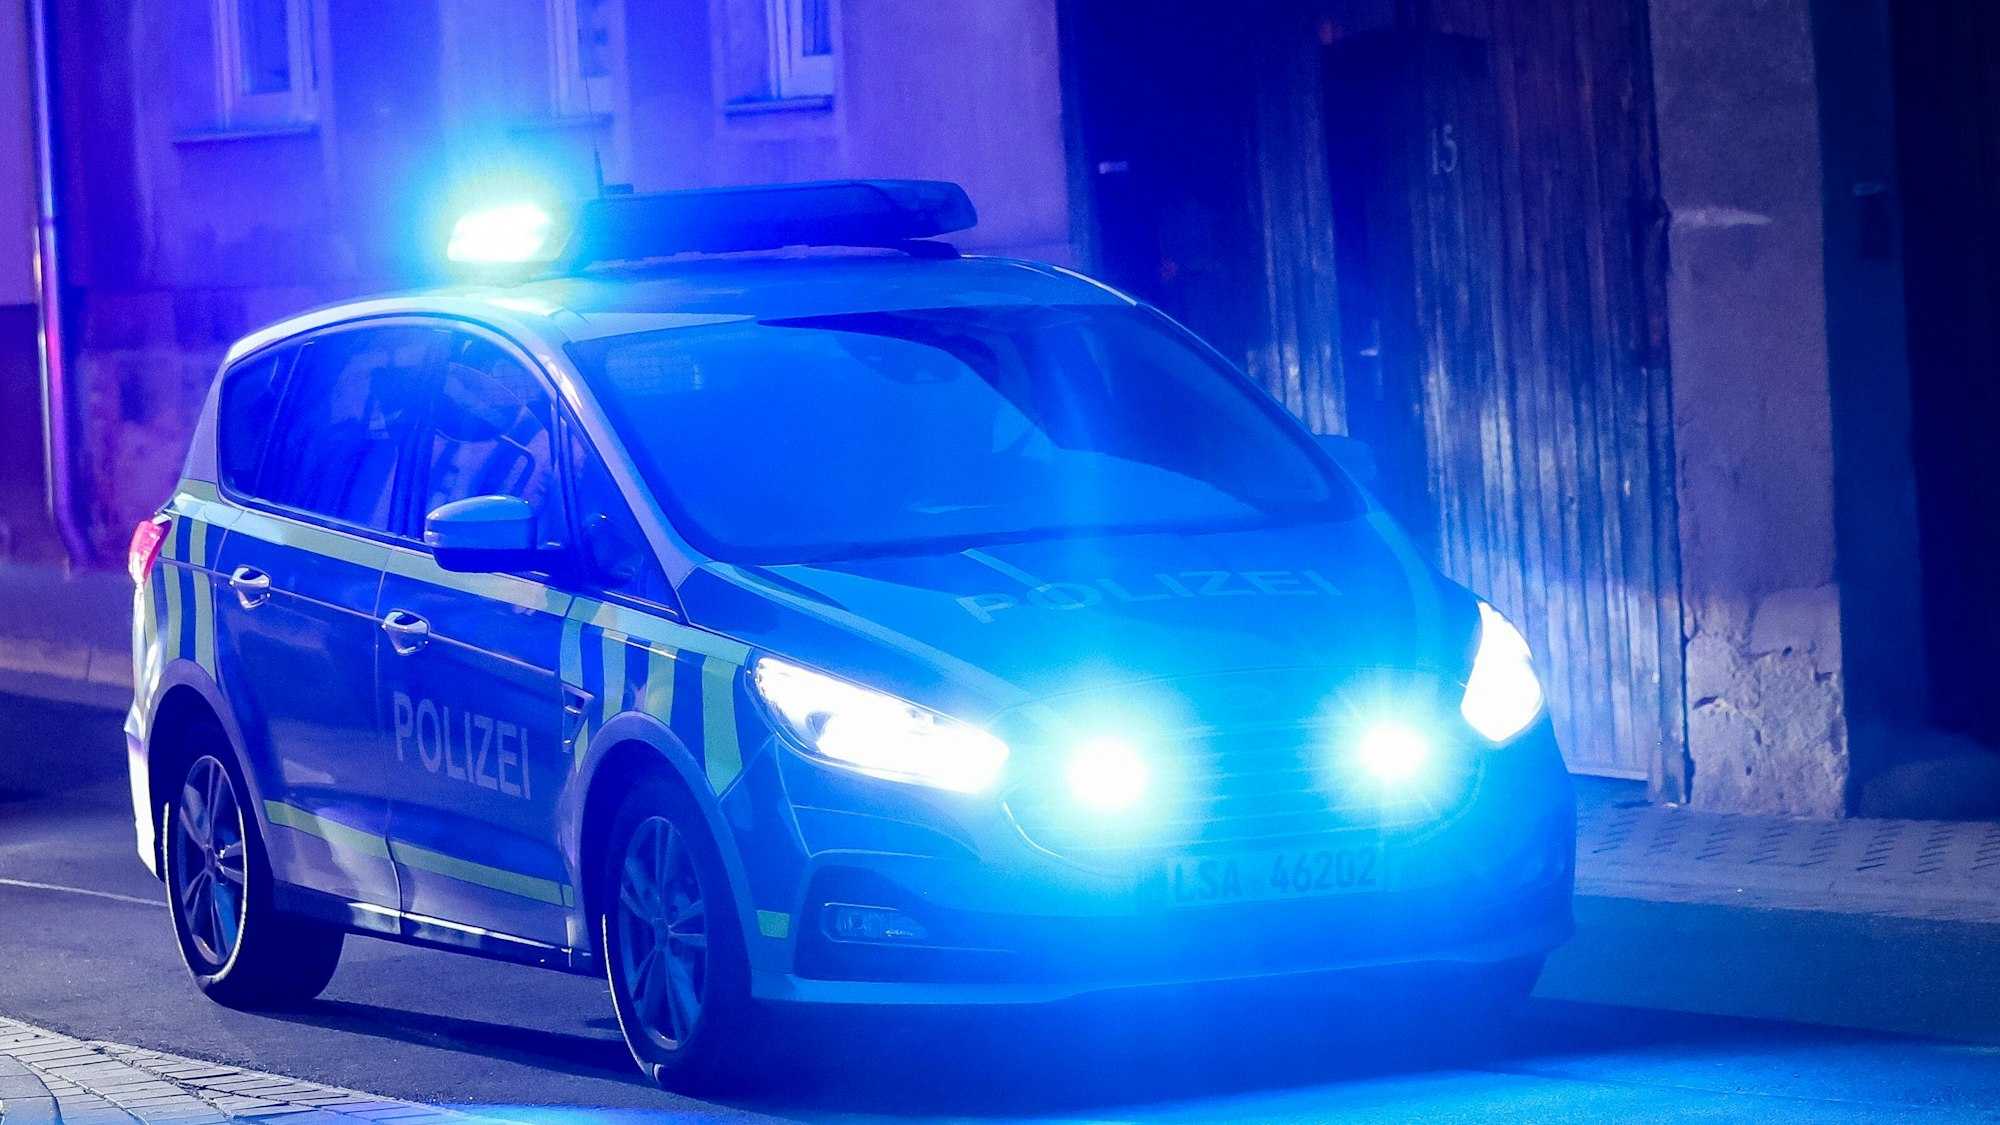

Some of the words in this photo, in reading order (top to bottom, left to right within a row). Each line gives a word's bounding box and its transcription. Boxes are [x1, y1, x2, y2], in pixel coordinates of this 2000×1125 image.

[1431, 124, 1458, 175] 15
[956, 570, 1343, 623] POLIZEI
[393, 691, 531, 800] POLIZEI
[1175, 858, 1243, 902] LSA
[1270, 847, 1376, 893] 46202
